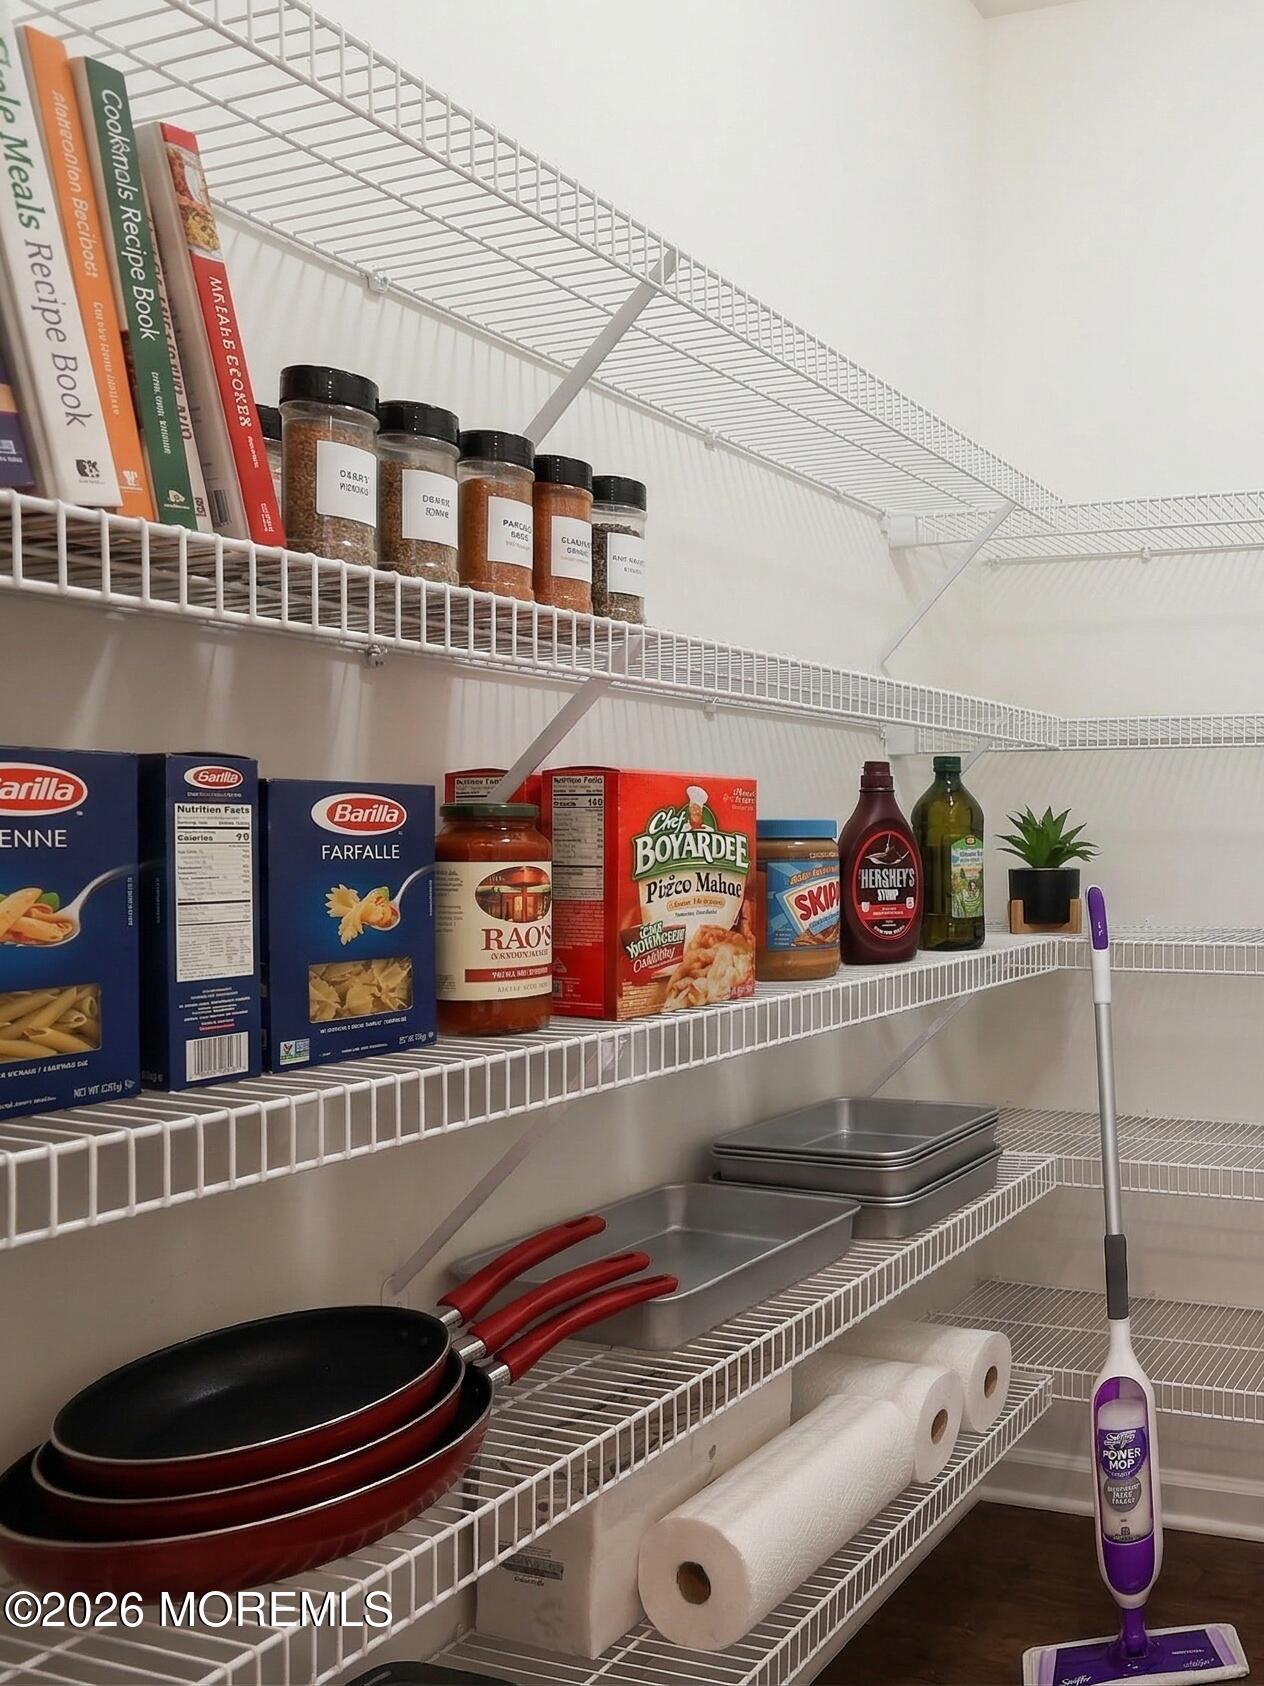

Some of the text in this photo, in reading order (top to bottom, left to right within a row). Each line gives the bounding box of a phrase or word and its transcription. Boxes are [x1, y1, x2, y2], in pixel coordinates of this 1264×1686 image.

[120, 204, 146, 282] Recipe
[0, 130, 46, 231] Meals
[24, 238, 67, 343] Recipe
[51, 352, 86, 427] Book
[132, 284, 160, 342] Book
[0, 777, 75, 801] arilla
[333, 804, 400, 823] Barilla
[648, 809, 686, 835] Chef
[0, 829, 68, 848] ENNE
[235, 832, 250, 841] 90
[321, 844, 400, 860] FARFALLE
[635, 832, 749, 875] BOYARDEE
[859, 868, 915, 888] HERSHEY'S
[481, 924, 551, 950] RAO'S
[1109, 1459, 1135, 1470] MOP
